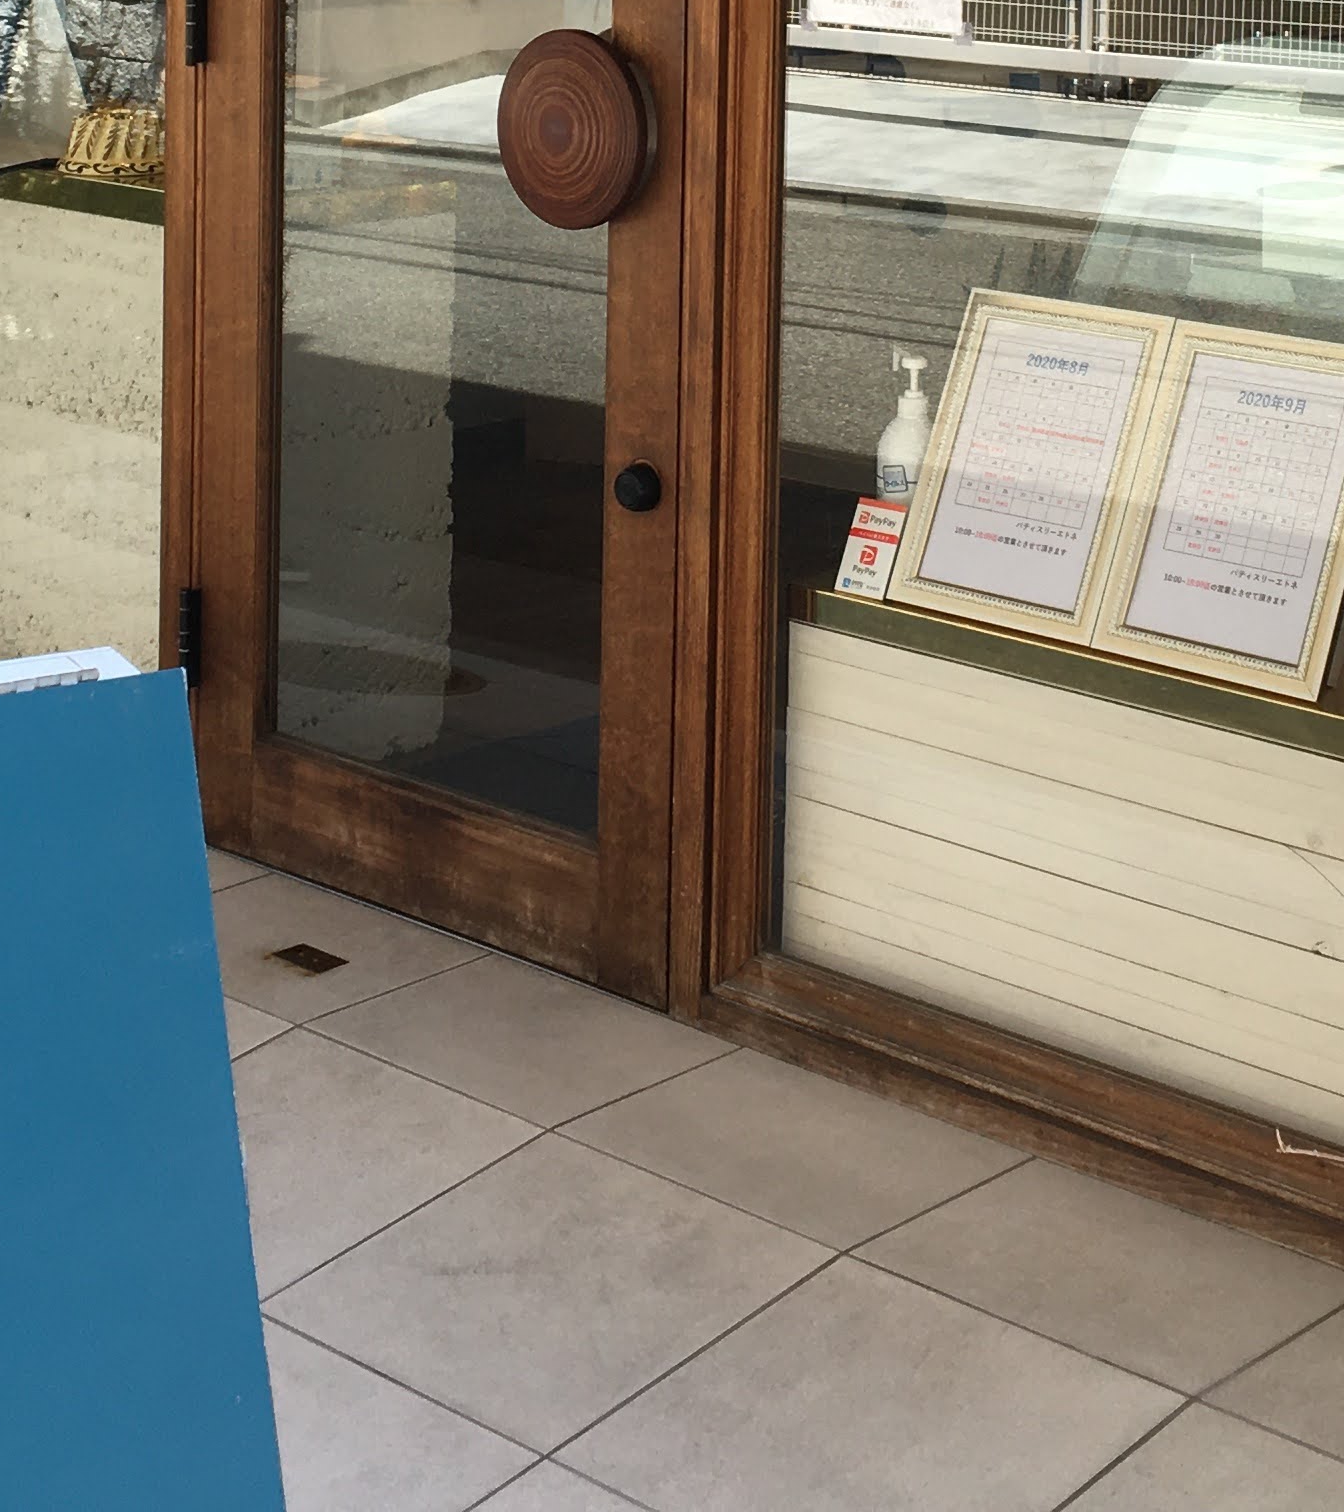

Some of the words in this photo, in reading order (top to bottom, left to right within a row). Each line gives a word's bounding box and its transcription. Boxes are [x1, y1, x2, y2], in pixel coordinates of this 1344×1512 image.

[1026, 353, 1090, 376] 2020年8月
[1237, 390, 1307, 415] 2020年9月
[870, 513, 896, 529] PayPay
[1016, 521, 1077, 540] パティスリーエトネ
[852, 564, 878, 578] PayPay
[1230, 569, 1298, 589] パティスリーエトネ
